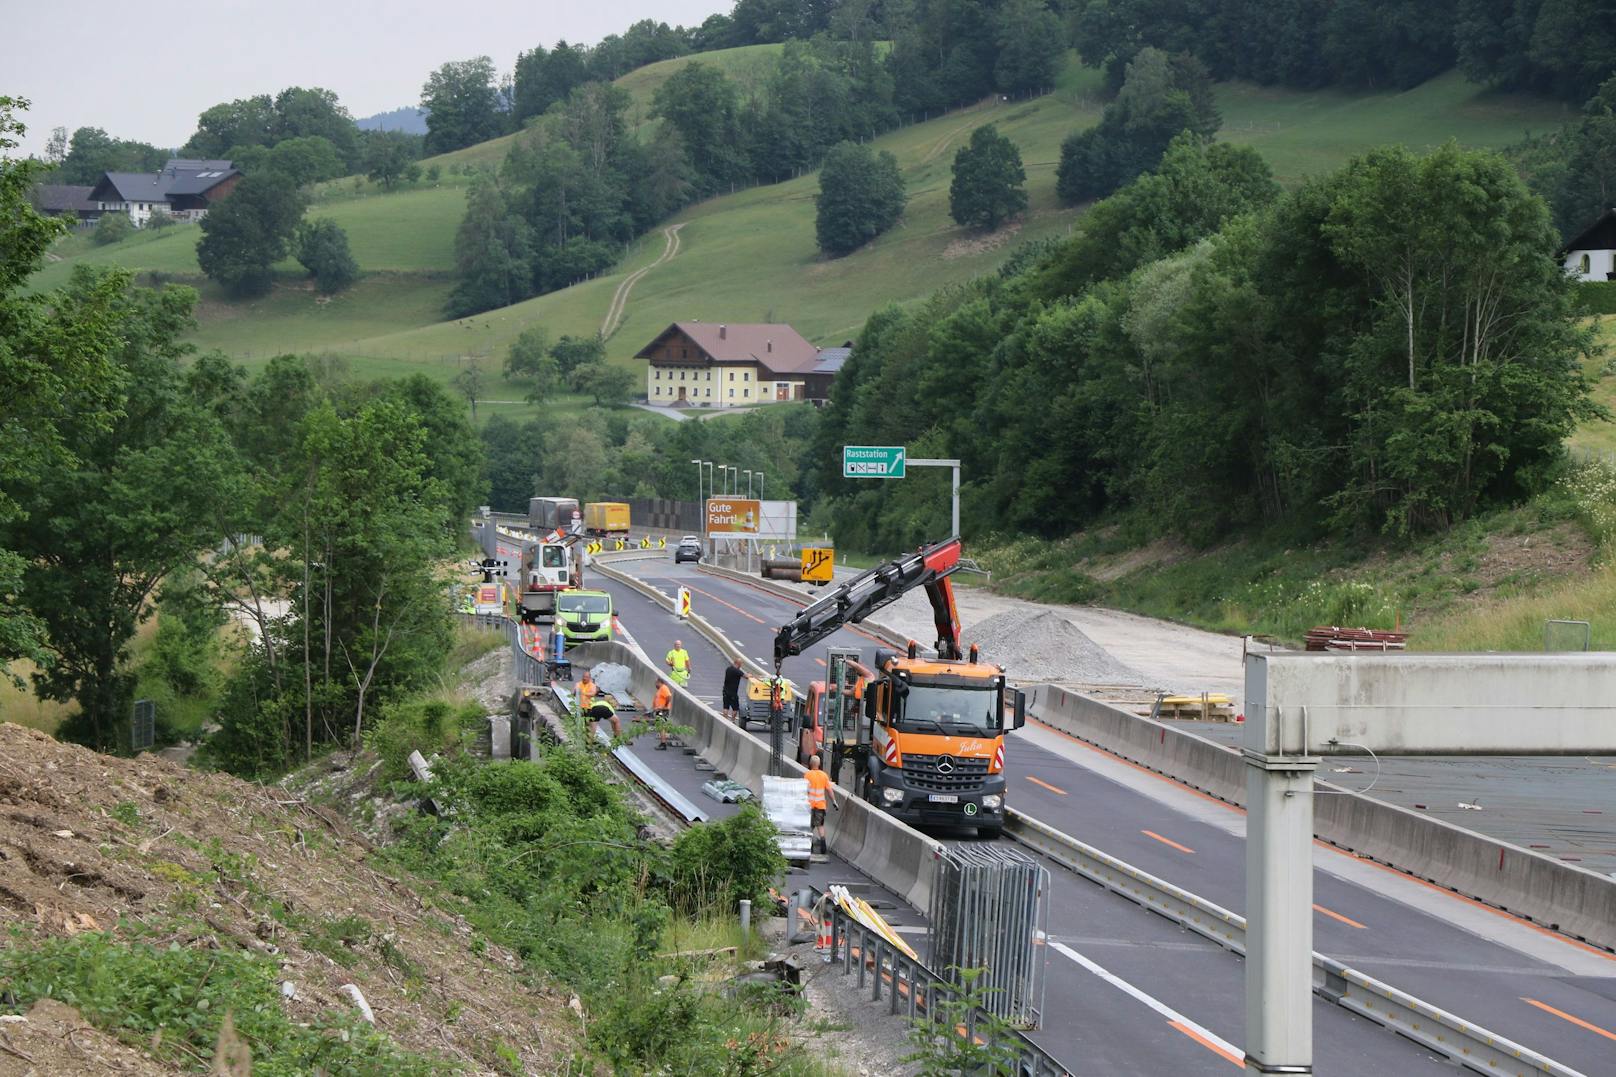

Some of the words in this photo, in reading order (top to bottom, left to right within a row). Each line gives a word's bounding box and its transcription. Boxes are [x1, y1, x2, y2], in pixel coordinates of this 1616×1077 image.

[846, 449, 888, 458] Raststation
[709, 502, 732, 513] Gute
[709, 514, 737, 525] Fahrt!
[967, 805, 973, 814] L
